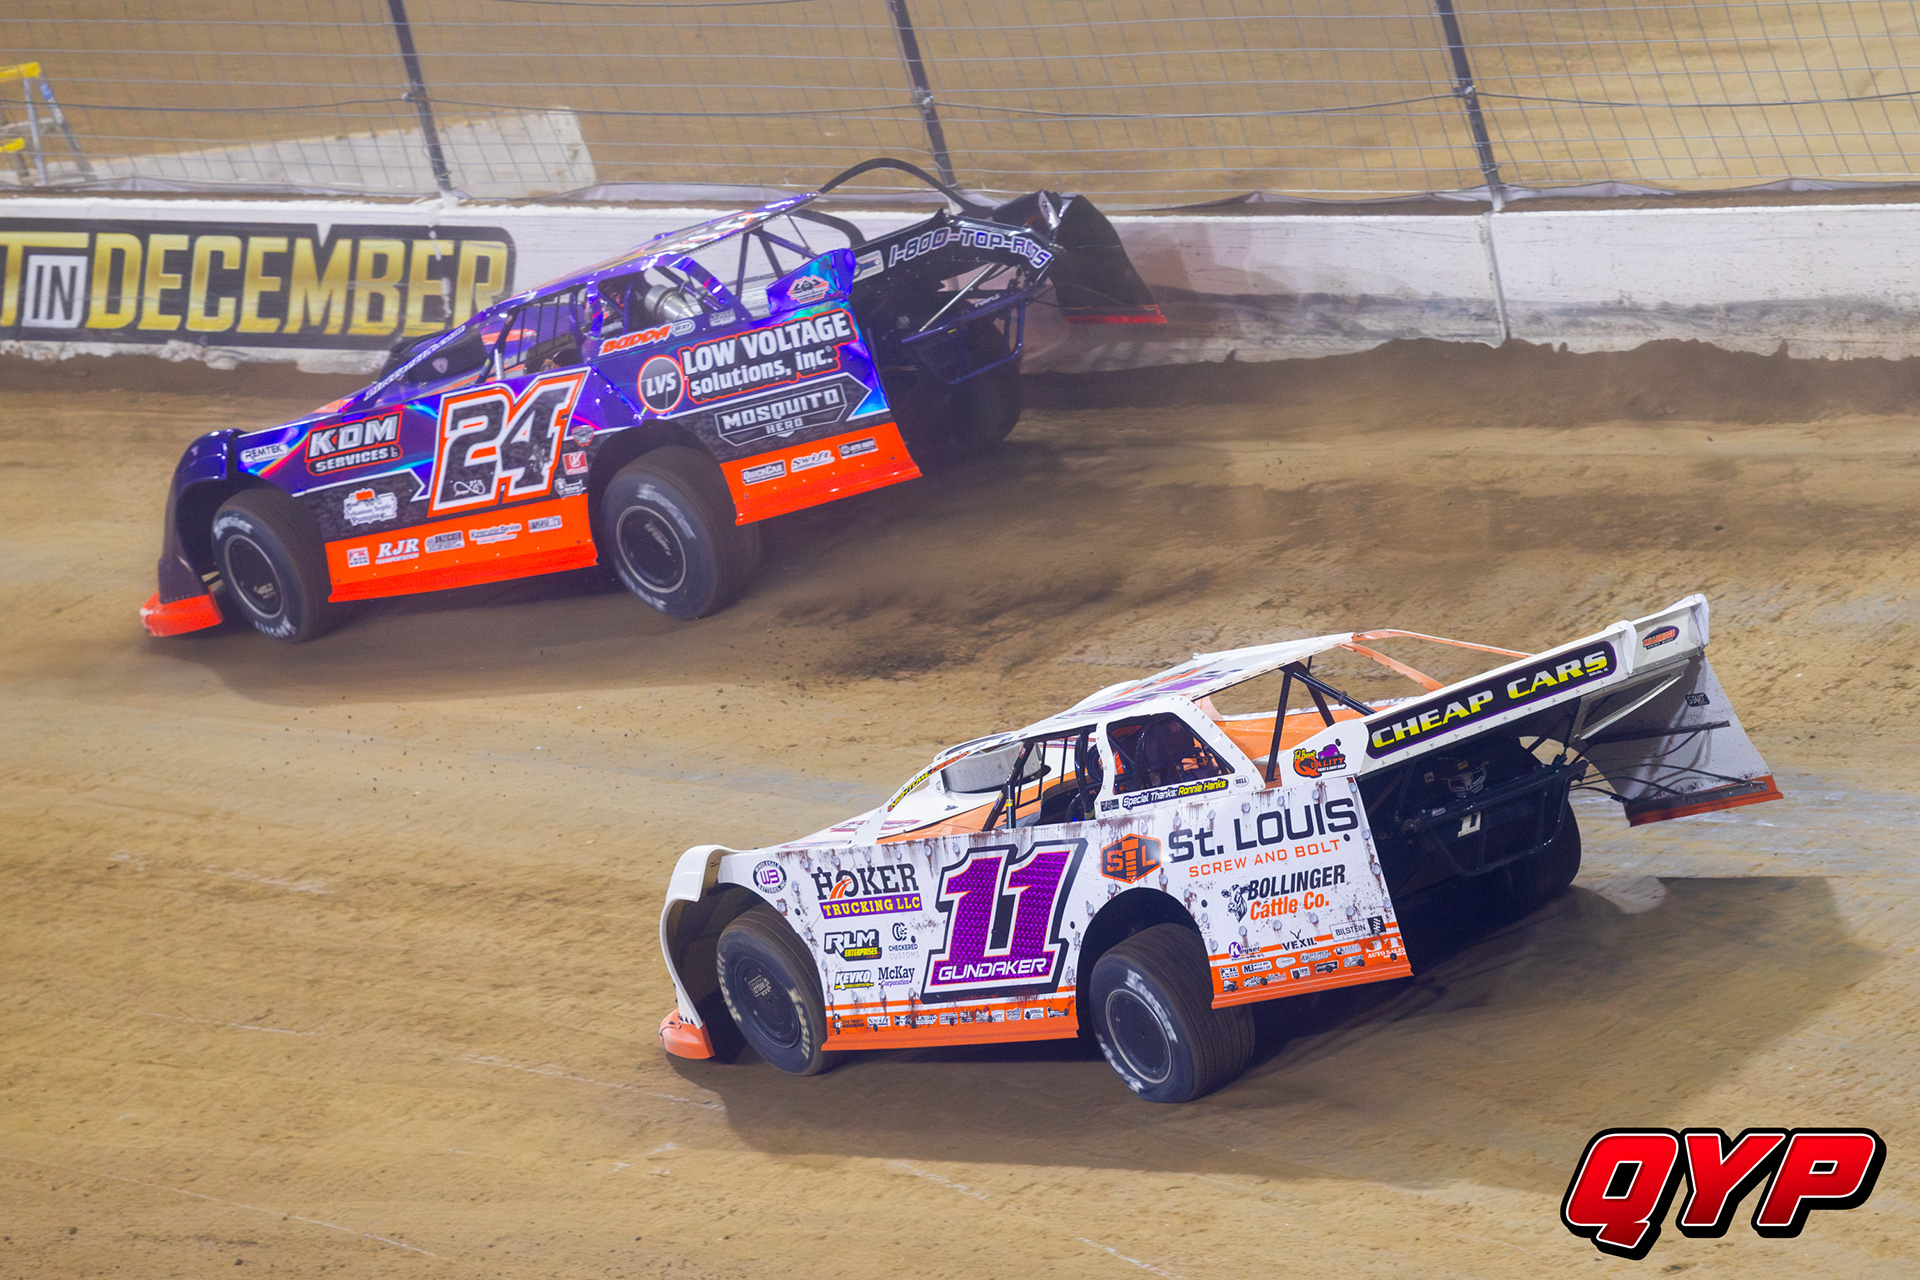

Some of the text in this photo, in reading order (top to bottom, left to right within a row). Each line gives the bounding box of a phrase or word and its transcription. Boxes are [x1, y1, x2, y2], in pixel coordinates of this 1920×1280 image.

[27, 260, 84, 325] IN
[86, 232, 509, 338] DECEMBER
[600, 324, 672, 355] BUDDA
[682, 312, 851, 376] LOW VOLTAGE
[646, 371, 677, 397] LVS
[690, 348, 834, 397] solutions, inc.
[720, 388, 840, 430] MOSQUITO
[308, 414, 400, 458] KDM
[766, 417, 804, 434] HERO
[428, 367, 591, 517] 24
[315, 447, 389, 473] SERVICES
[376, 537, 420, 559] RJR
[1371, 650, 1609, 749] CHEAP CARS
[1235, 777, 1248, 785] BELL
[1294, 756, 1345, 777] QUALITY
[1122, 793, 1149, 809] Special
[1178, 784, 1203, 797] Ronnie
[1203, 779, 1227, 791] Hanks
[1168, 797, 1359, 864] St. LOUIS
[1188, 838, 1341, 878] SCREW AND BOLT
[811, 863, 920, 901] HOKER
[1247, 863, 1346, 901] BOLLINGER
[822, 896, 921, 917] TRUCKING LLC
[924, 839, 1086, 1002] 11
[1249, 891, 1330, 921] Cattle Co.
[825, 929, 878, 954] RLM
[1334, 924, 1367, 936] BILSTEIN
[888, 943, 919, 952] CHECKERED
[888, 951, 920, 960] CUSTOMS
[835, 970, 873, 989] KEVKO
[878, 966, 916, 983] McKay
[938, 957, 1048, 981] GUNDAKER
